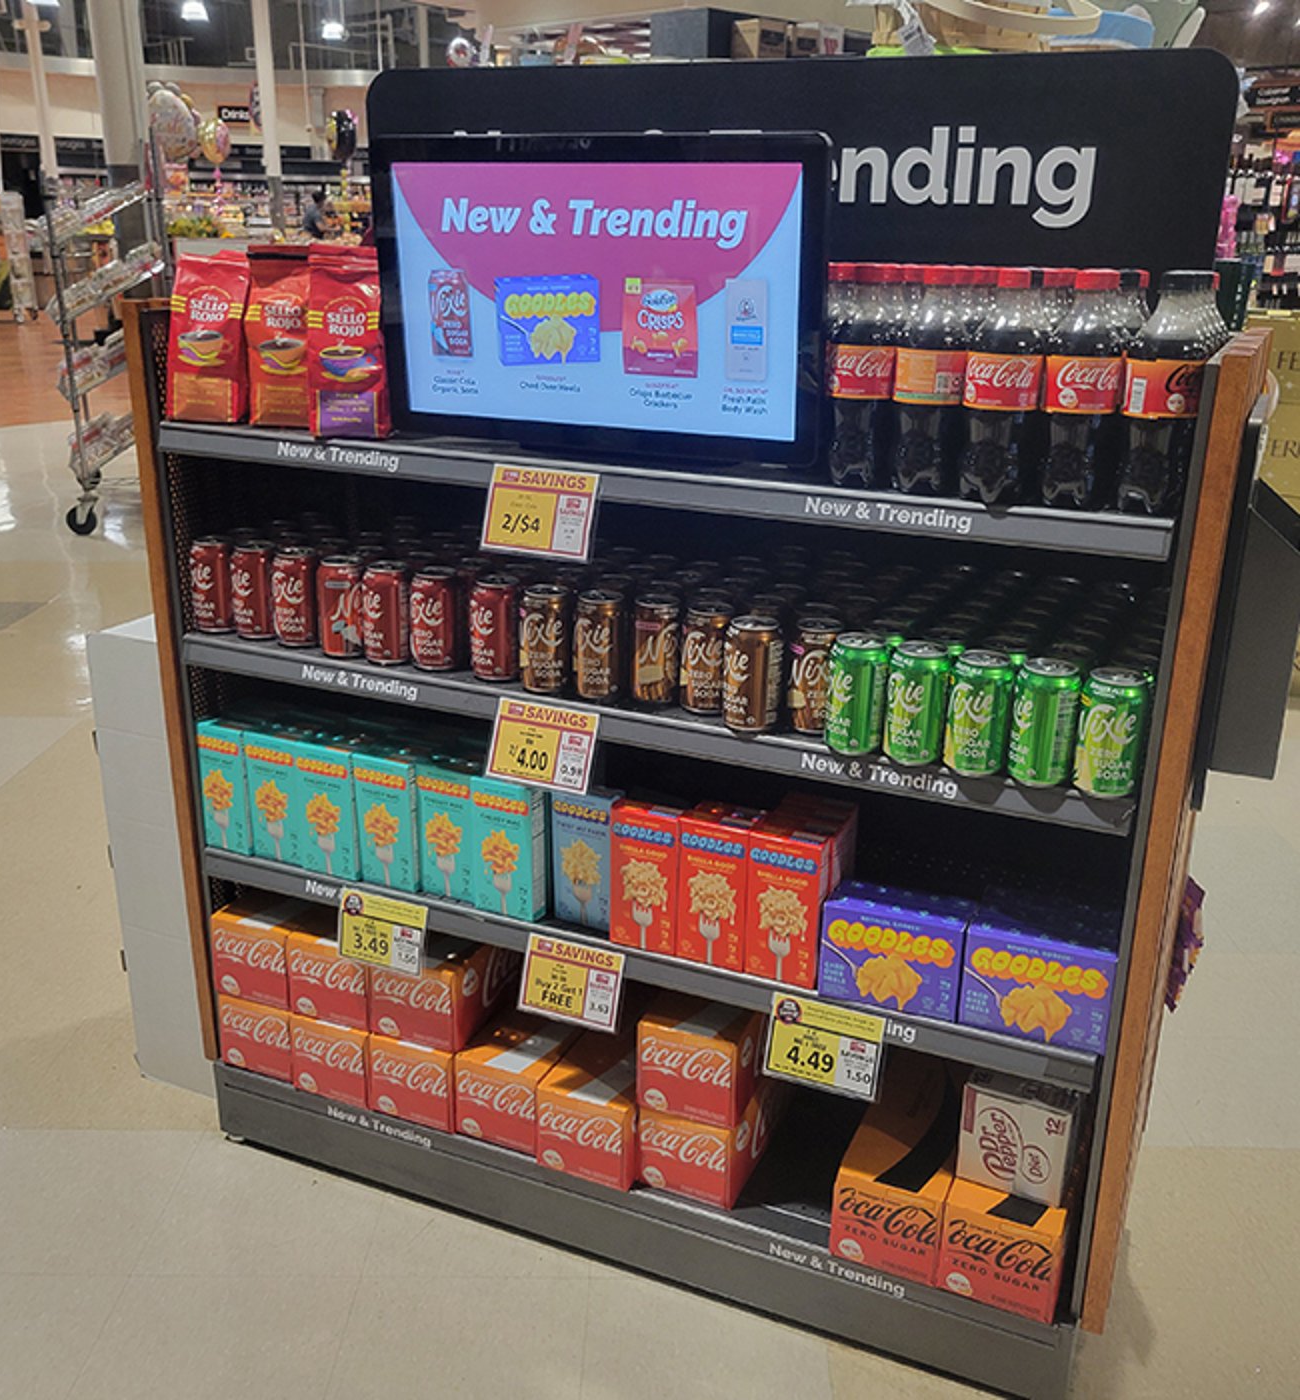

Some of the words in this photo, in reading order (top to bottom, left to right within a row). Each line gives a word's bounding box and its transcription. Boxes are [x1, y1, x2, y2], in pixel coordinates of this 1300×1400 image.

[832, 126, 1097, 228] nding
[441, 198, 520, 233] New
[529, 199, 557, 236] &
[568, 199, 748, 249] Trending
[189, 299, 229, 312] SELLO
[327, 312, 367, 325] SELLO
[328, 324, 365, 337] ROJO
[276, 442, 312, 458] New
[314, 446, 327, 460] &
[329, 447, 399, 472] Trending
[522, 471, 587, 490] SAVINGS
[805, 496, 851, 518] New
[855, 501, 870, 520] &
[876, 503, 972, 534] Trending
[302, 665, 334, 685] New
[337, 672, 350, 687] &
[351, 673, 419, 701] Trending
[526, 706, 589, 728] SAVINGS
[517, 748, 549, 771] 4.00
[801, 753, 843, 776] New
[849, 761, 863, 779] &
[869, 763, 958, 799] Trending
[305, 880, 335, 899] New
[354, 932, 389, 956] 3.49
[556, 943, 614, 967] SAVINGS
[541, 990, 573, 1008] FREE
[786, 1046, 834, 1073] 4.49
[846, 1069, 871, 1085] 1.50
[328, 1105, 357, 1125] New
[359, 1115, 370, 1129] &
[371, 1117, 432, 1148] Trending
[978, 1125, 1000, 1152] Dr
[1045, 1116, 1061, 1136] 12
[982, 1112, 1018, 1181] Pepper
[843, 1223, 876, 1242] ZERO
[882, 1237, 926, 1257] SUGAR
[769, 1242, 807, 1266] New
[810, 1254, 824, 1270] &
[826, 1258, 905, 1298] Trending
[952, 1257, 988, 1277] ZERO
[993, 1271, 1040, 1292] SUGAR
